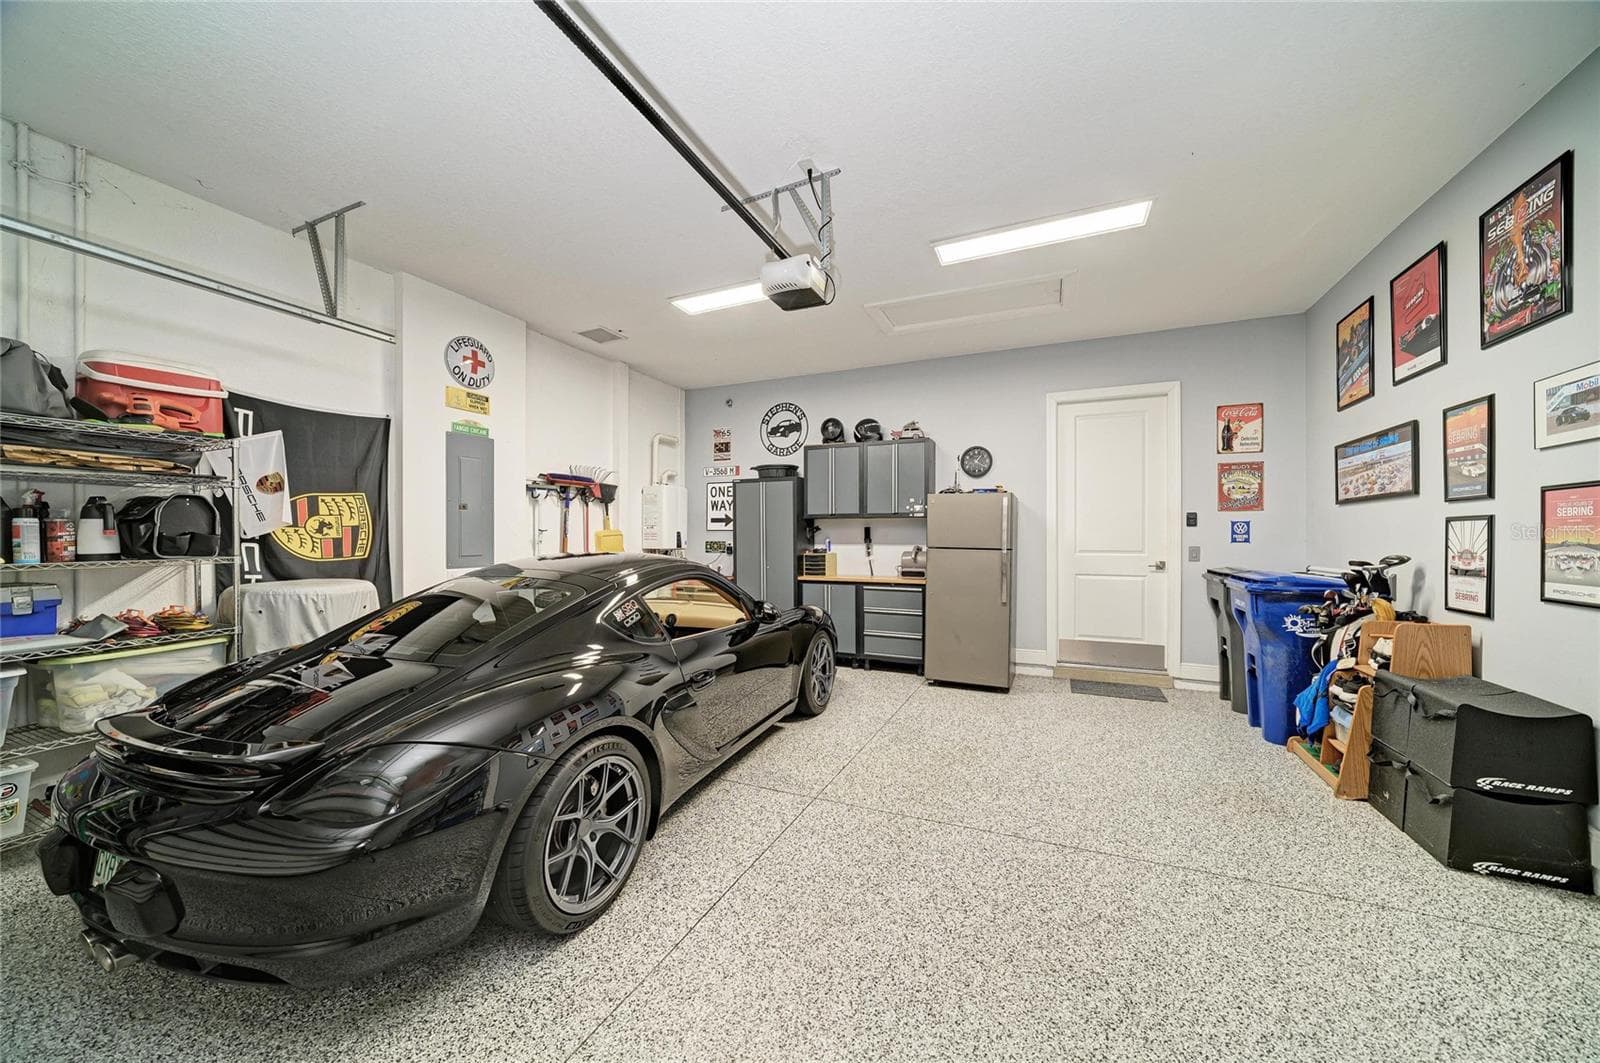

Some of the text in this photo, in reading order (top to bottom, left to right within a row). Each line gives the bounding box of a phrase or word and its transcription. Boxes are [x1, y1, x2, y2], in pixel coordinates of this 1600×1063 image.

[450, 337, 493, 363] LIFEGUARD
[452, 365, 491, 388] ON DUTY
[1575, 378, 1599, 391] Mobil
[1448, 430, 1478, 445] SEBRING
[767, 441, 803, 456] GARAGE
[710, 486, 733, 498] ONE
[710, 500, 733, 512] WAY
[1556, 506, 1594, 517] SEBRING
[355, 495, 370, 554] PORSCHE
[1455, 591, 1479, 603] SEBRING
[1491, 780, 1573, 796] RACE RAMPS
[1488, 864, 1569, 884] RACE RAMPS
